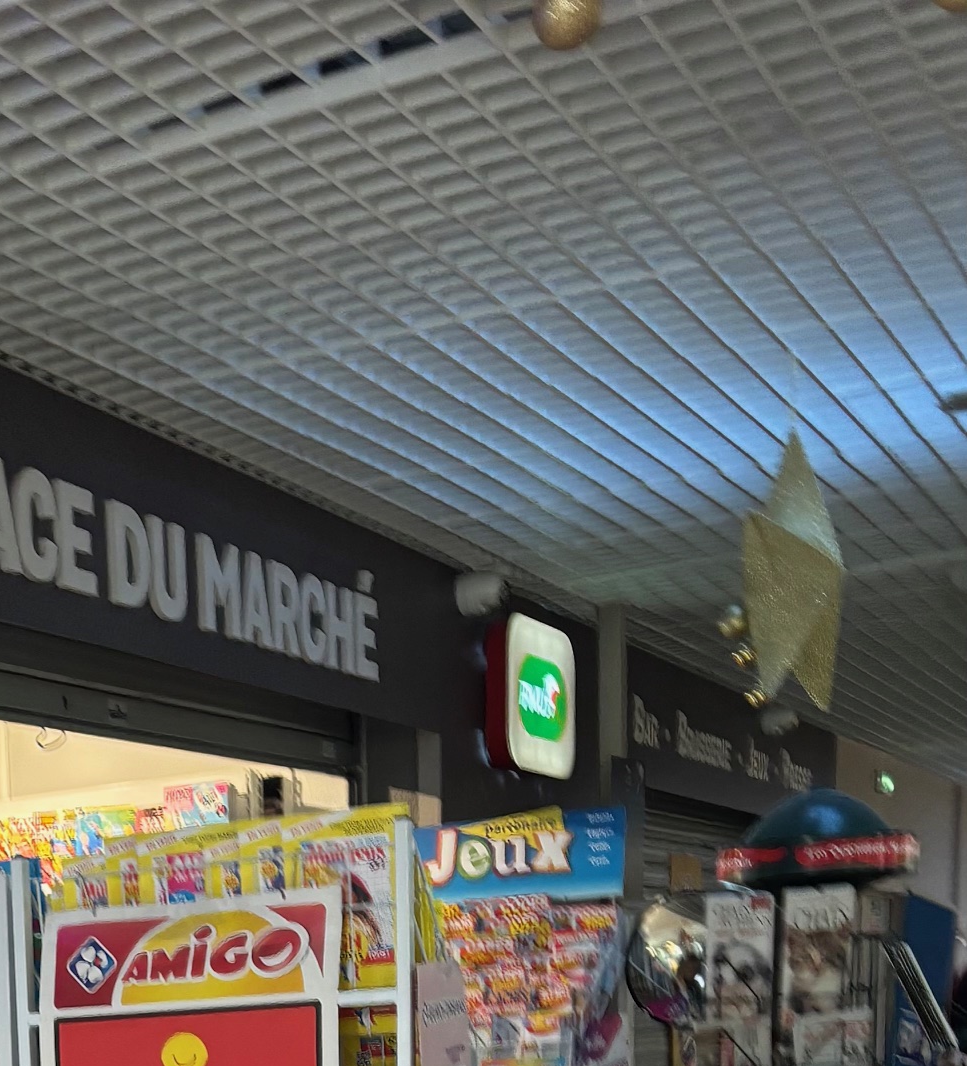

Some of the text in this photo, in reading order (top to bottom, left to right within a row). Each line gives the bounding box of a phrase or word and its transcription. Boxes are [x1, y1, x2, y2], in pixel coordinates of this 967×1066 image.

[105, 498, 188, 621] DU
[194, 531, 380, 683] MARCHÉ
[424, 827, 574, 886] Jeux
